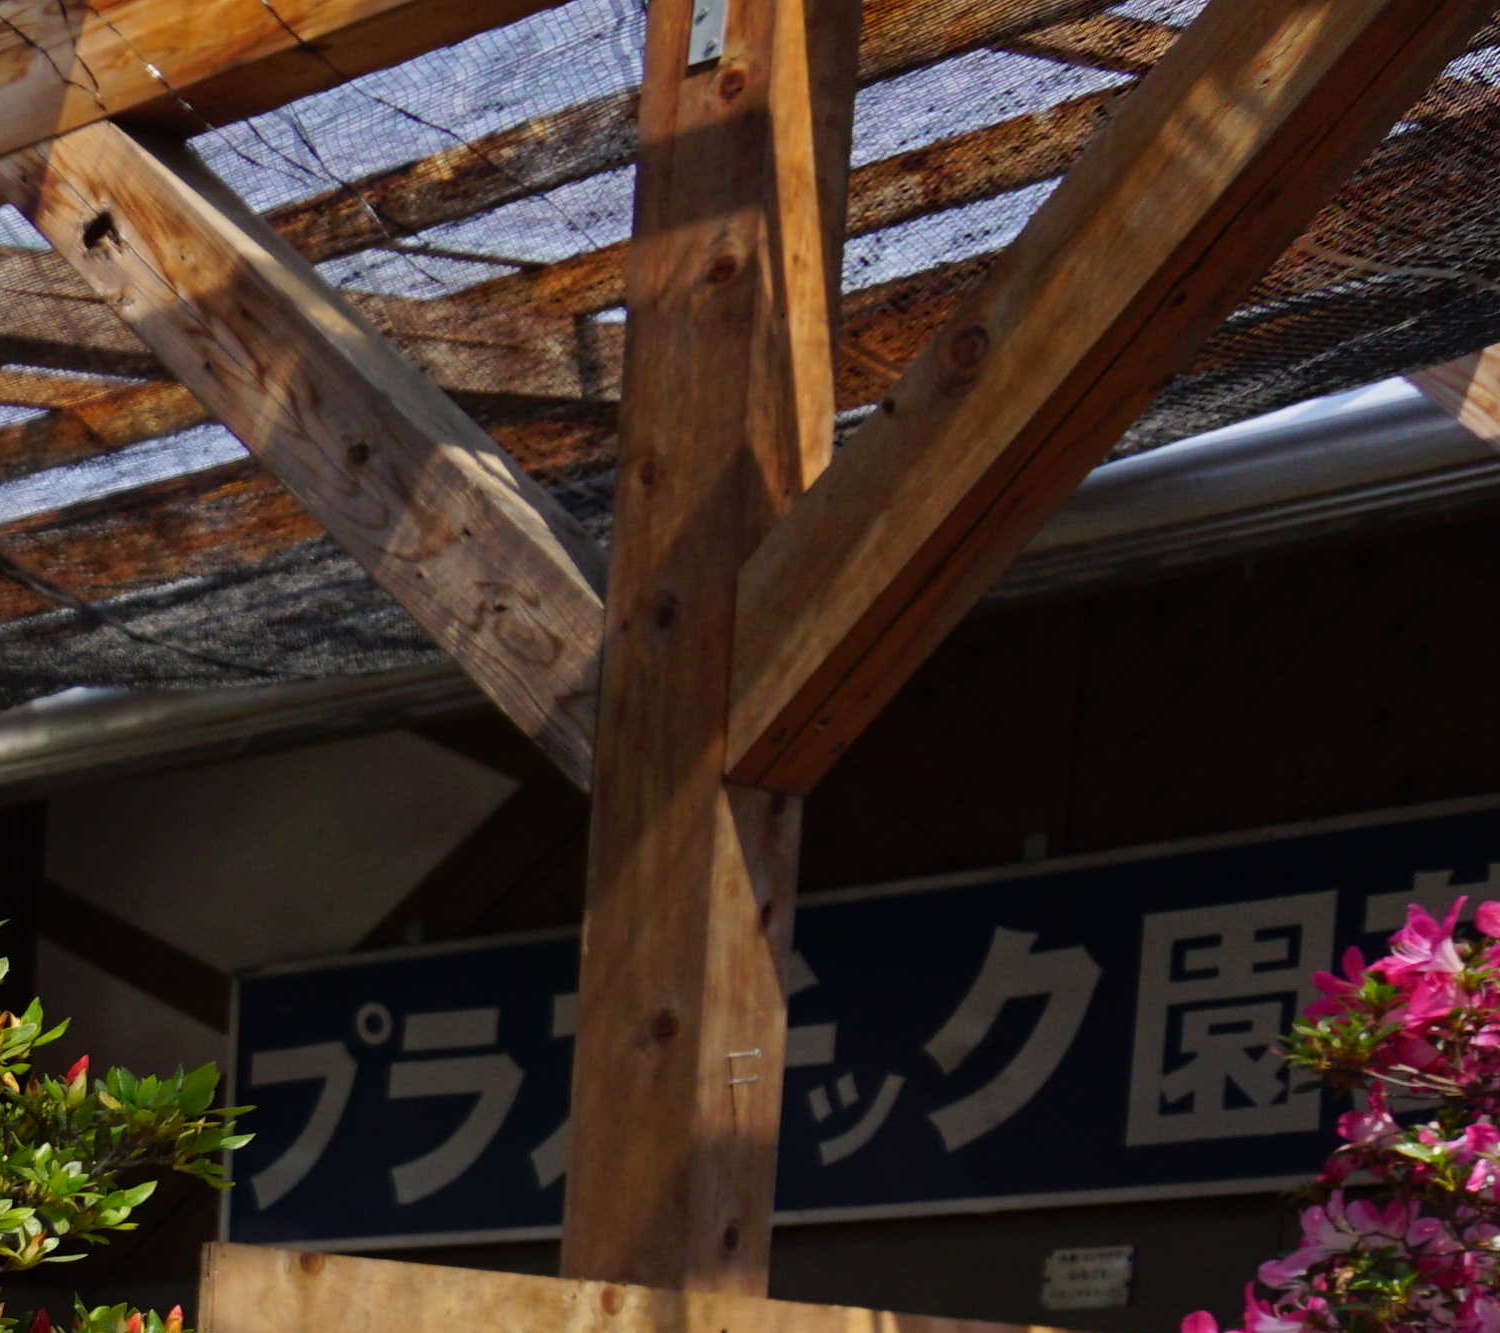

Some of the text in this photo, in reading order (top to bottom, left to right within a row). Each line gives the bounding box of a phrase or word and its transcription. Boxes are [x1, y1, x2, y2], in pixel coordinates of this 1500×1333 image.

[249, 867, 1500, 1209] プラック園
